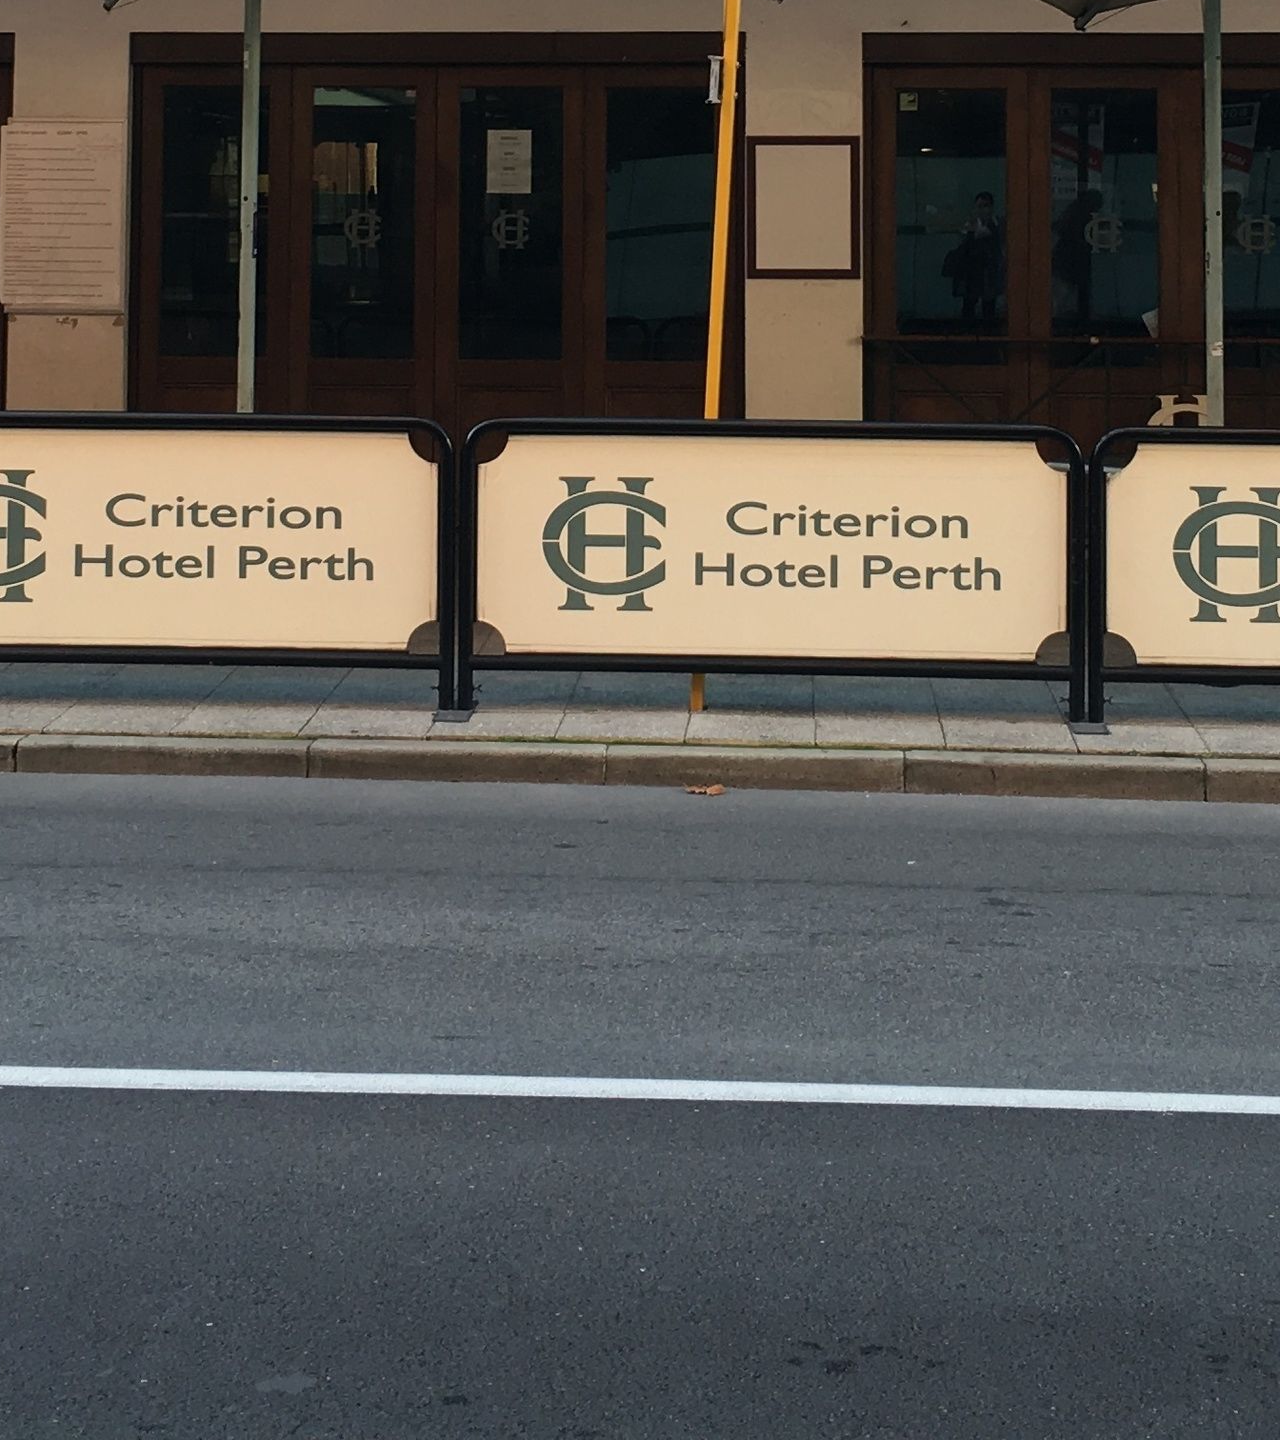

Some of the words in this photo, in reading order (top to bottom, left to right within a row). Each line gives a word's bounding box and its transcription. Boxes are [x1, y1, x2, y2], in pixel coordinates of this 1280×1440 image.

[105, 493, 342, 530] Criterion
[726, 501, 969, 539] Criterion
[74, 544, 215, 579] Hotel
[238, 546, 374, 581] Perth
[694, 553, 838, 589] Hotel
[862, 555, 1001, 591] Perth
